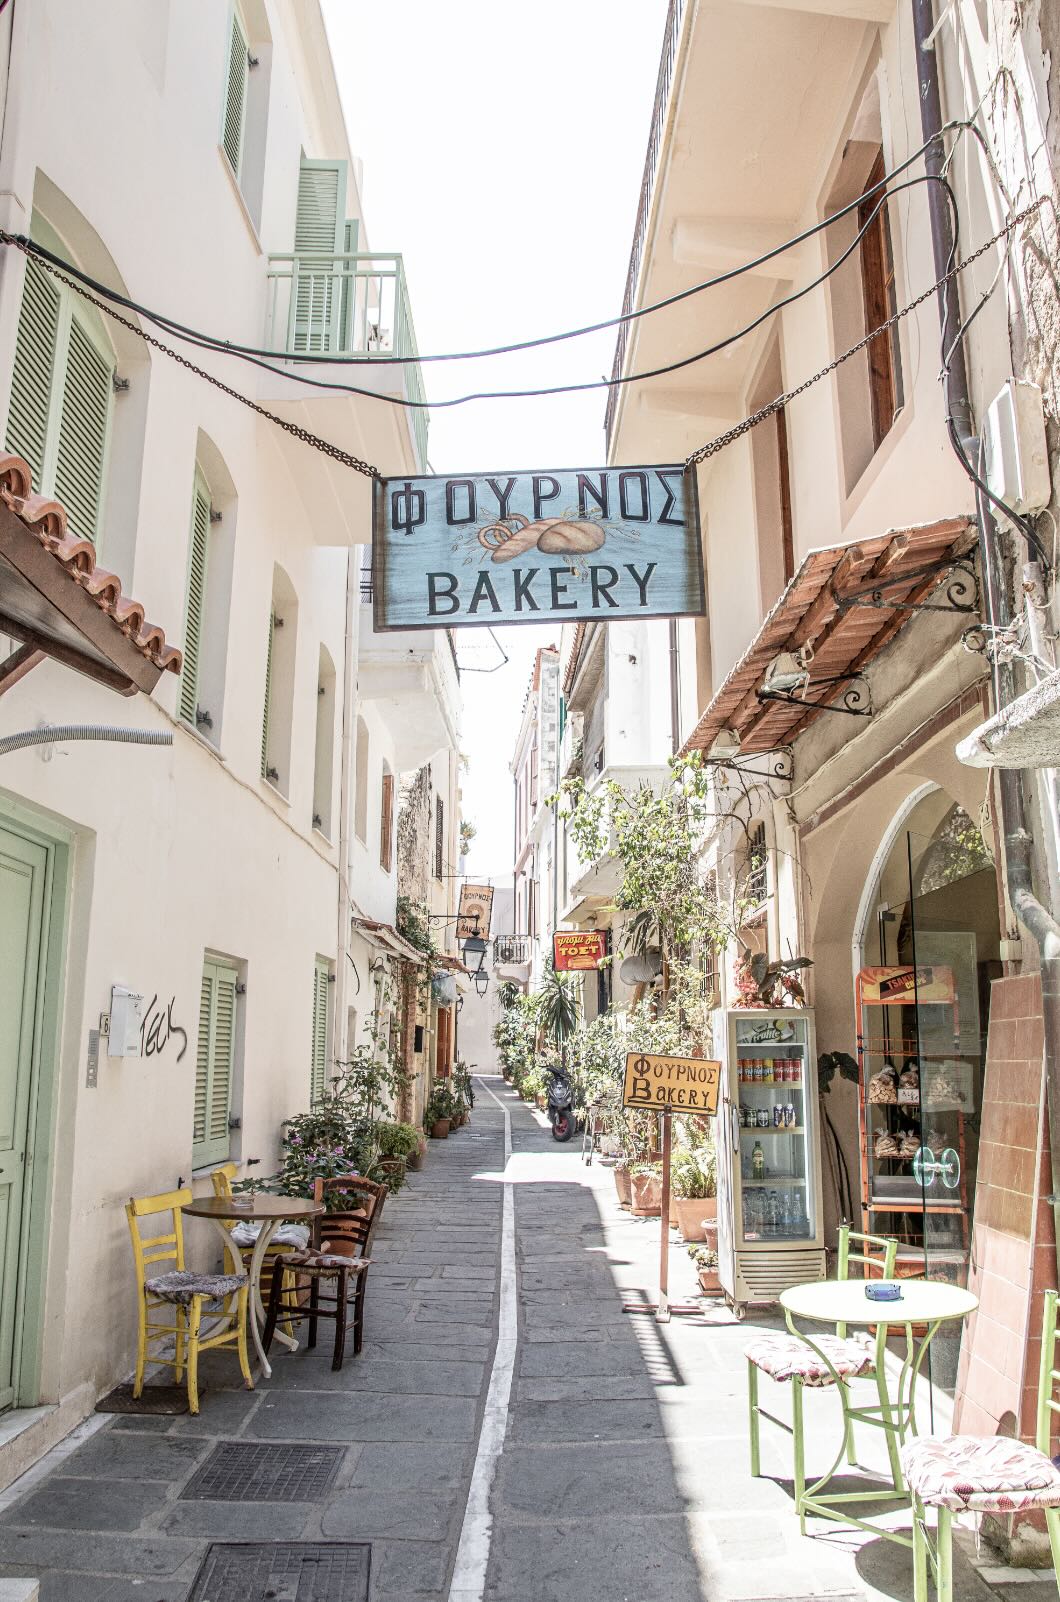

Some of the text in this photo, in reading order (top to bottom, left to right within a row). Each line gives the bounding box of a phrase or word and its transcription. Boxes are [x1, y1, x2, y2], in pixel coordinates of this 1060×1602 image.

[391, 469, 688, 536] ΦΟΥΡΝΟΣ
[426, 562, 658, 616] BAKERY
[461, 924, 486, 934] BAKY
[886, 970, 927, 990] TSAKIS
[904, 976, 928, 990] CHPS
[633, 1054, 717, 1085] ΦΟΥΡΝΟΣ
